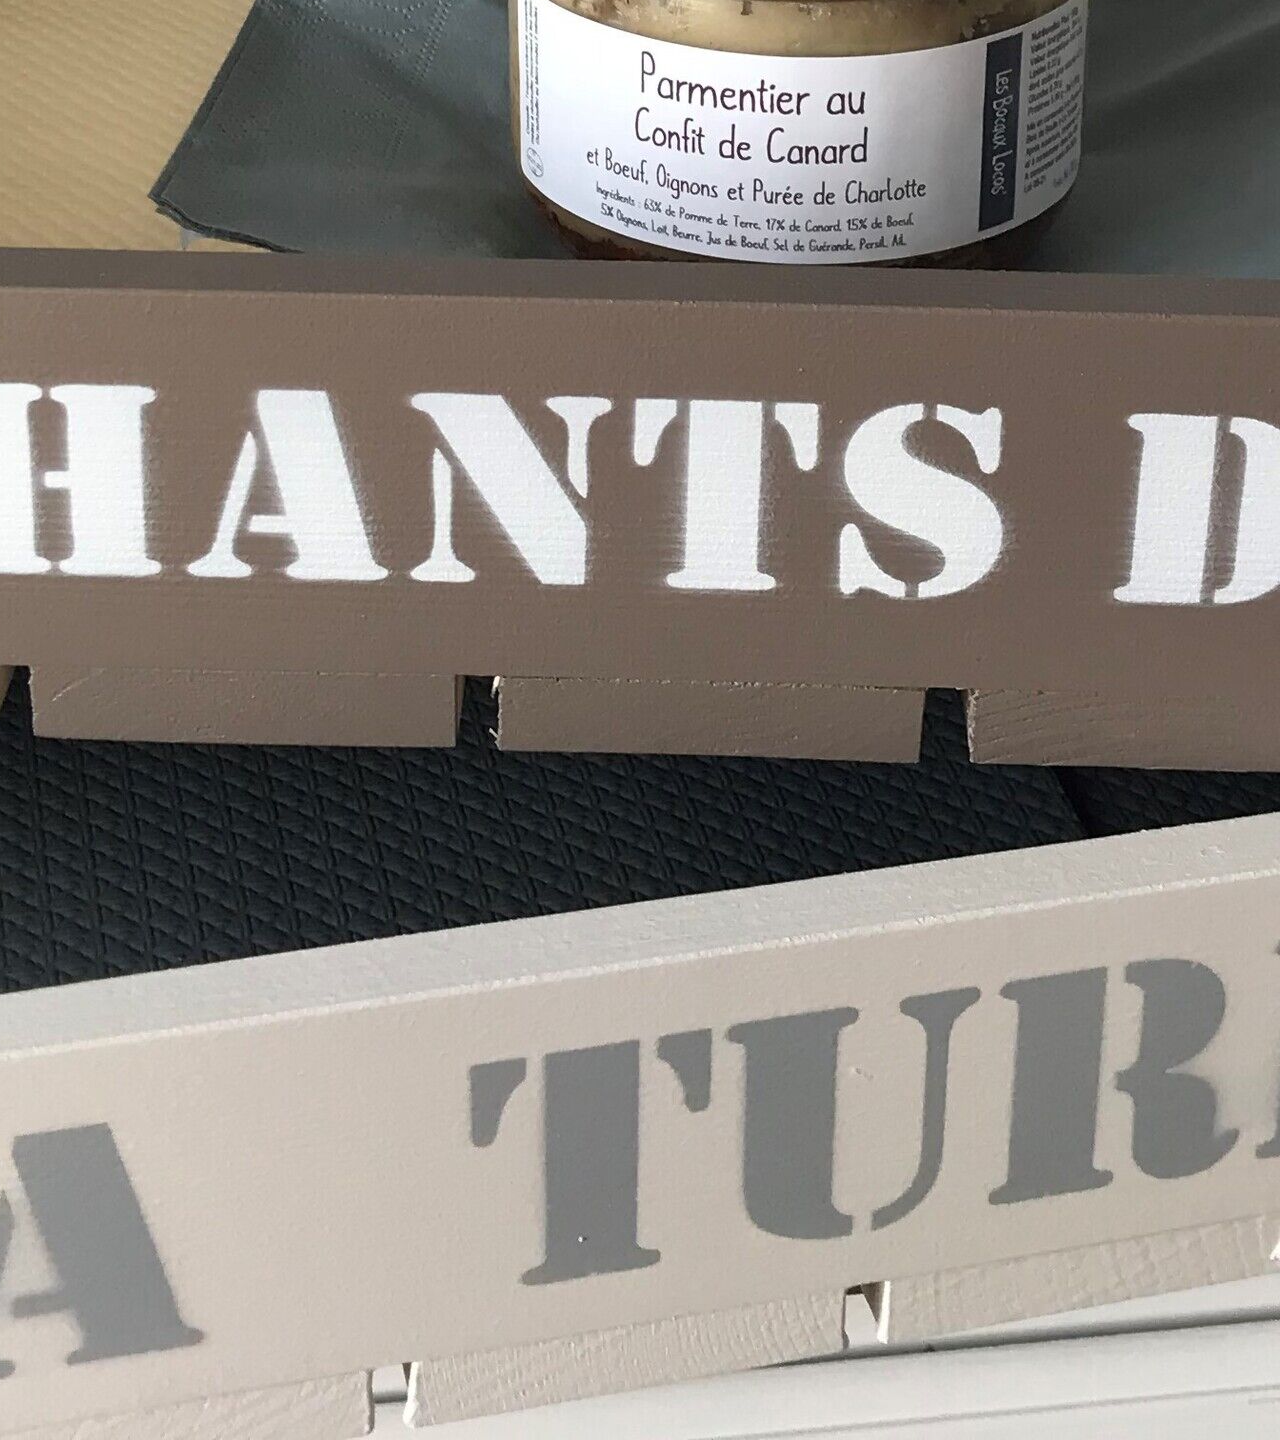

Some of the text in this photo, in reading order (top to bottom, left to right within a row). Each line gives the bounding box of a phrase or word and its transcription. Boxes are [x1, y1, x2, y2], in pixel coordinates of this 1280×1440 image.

[640, 50, 866, 116] Parmentier au
[994, 69, 1012, 95] Les
[634, 106, 869, 165] Confit de Canard
[992, 94, 1013, 150] Bocaux
[586, 147, 599, 166] et
[656, 163, 719, 200] Oignons
[726, 182, 745, 202] et
[753, 178, 804, 206] Purée
[813, 181, 836, 206] de
[845, 177, 927, 205] Charlotte
[665, 204, 676, 218] de
[679, 206, 714, 225] Pomme
[716, 213, 729, 227] de
[765, 218, 786, 232] 17%
[789, 219, 802, 233] de
[871, 216, 883, 230] de
[725, 234, 738, 248] de
[793, 239, 805, 252] de
